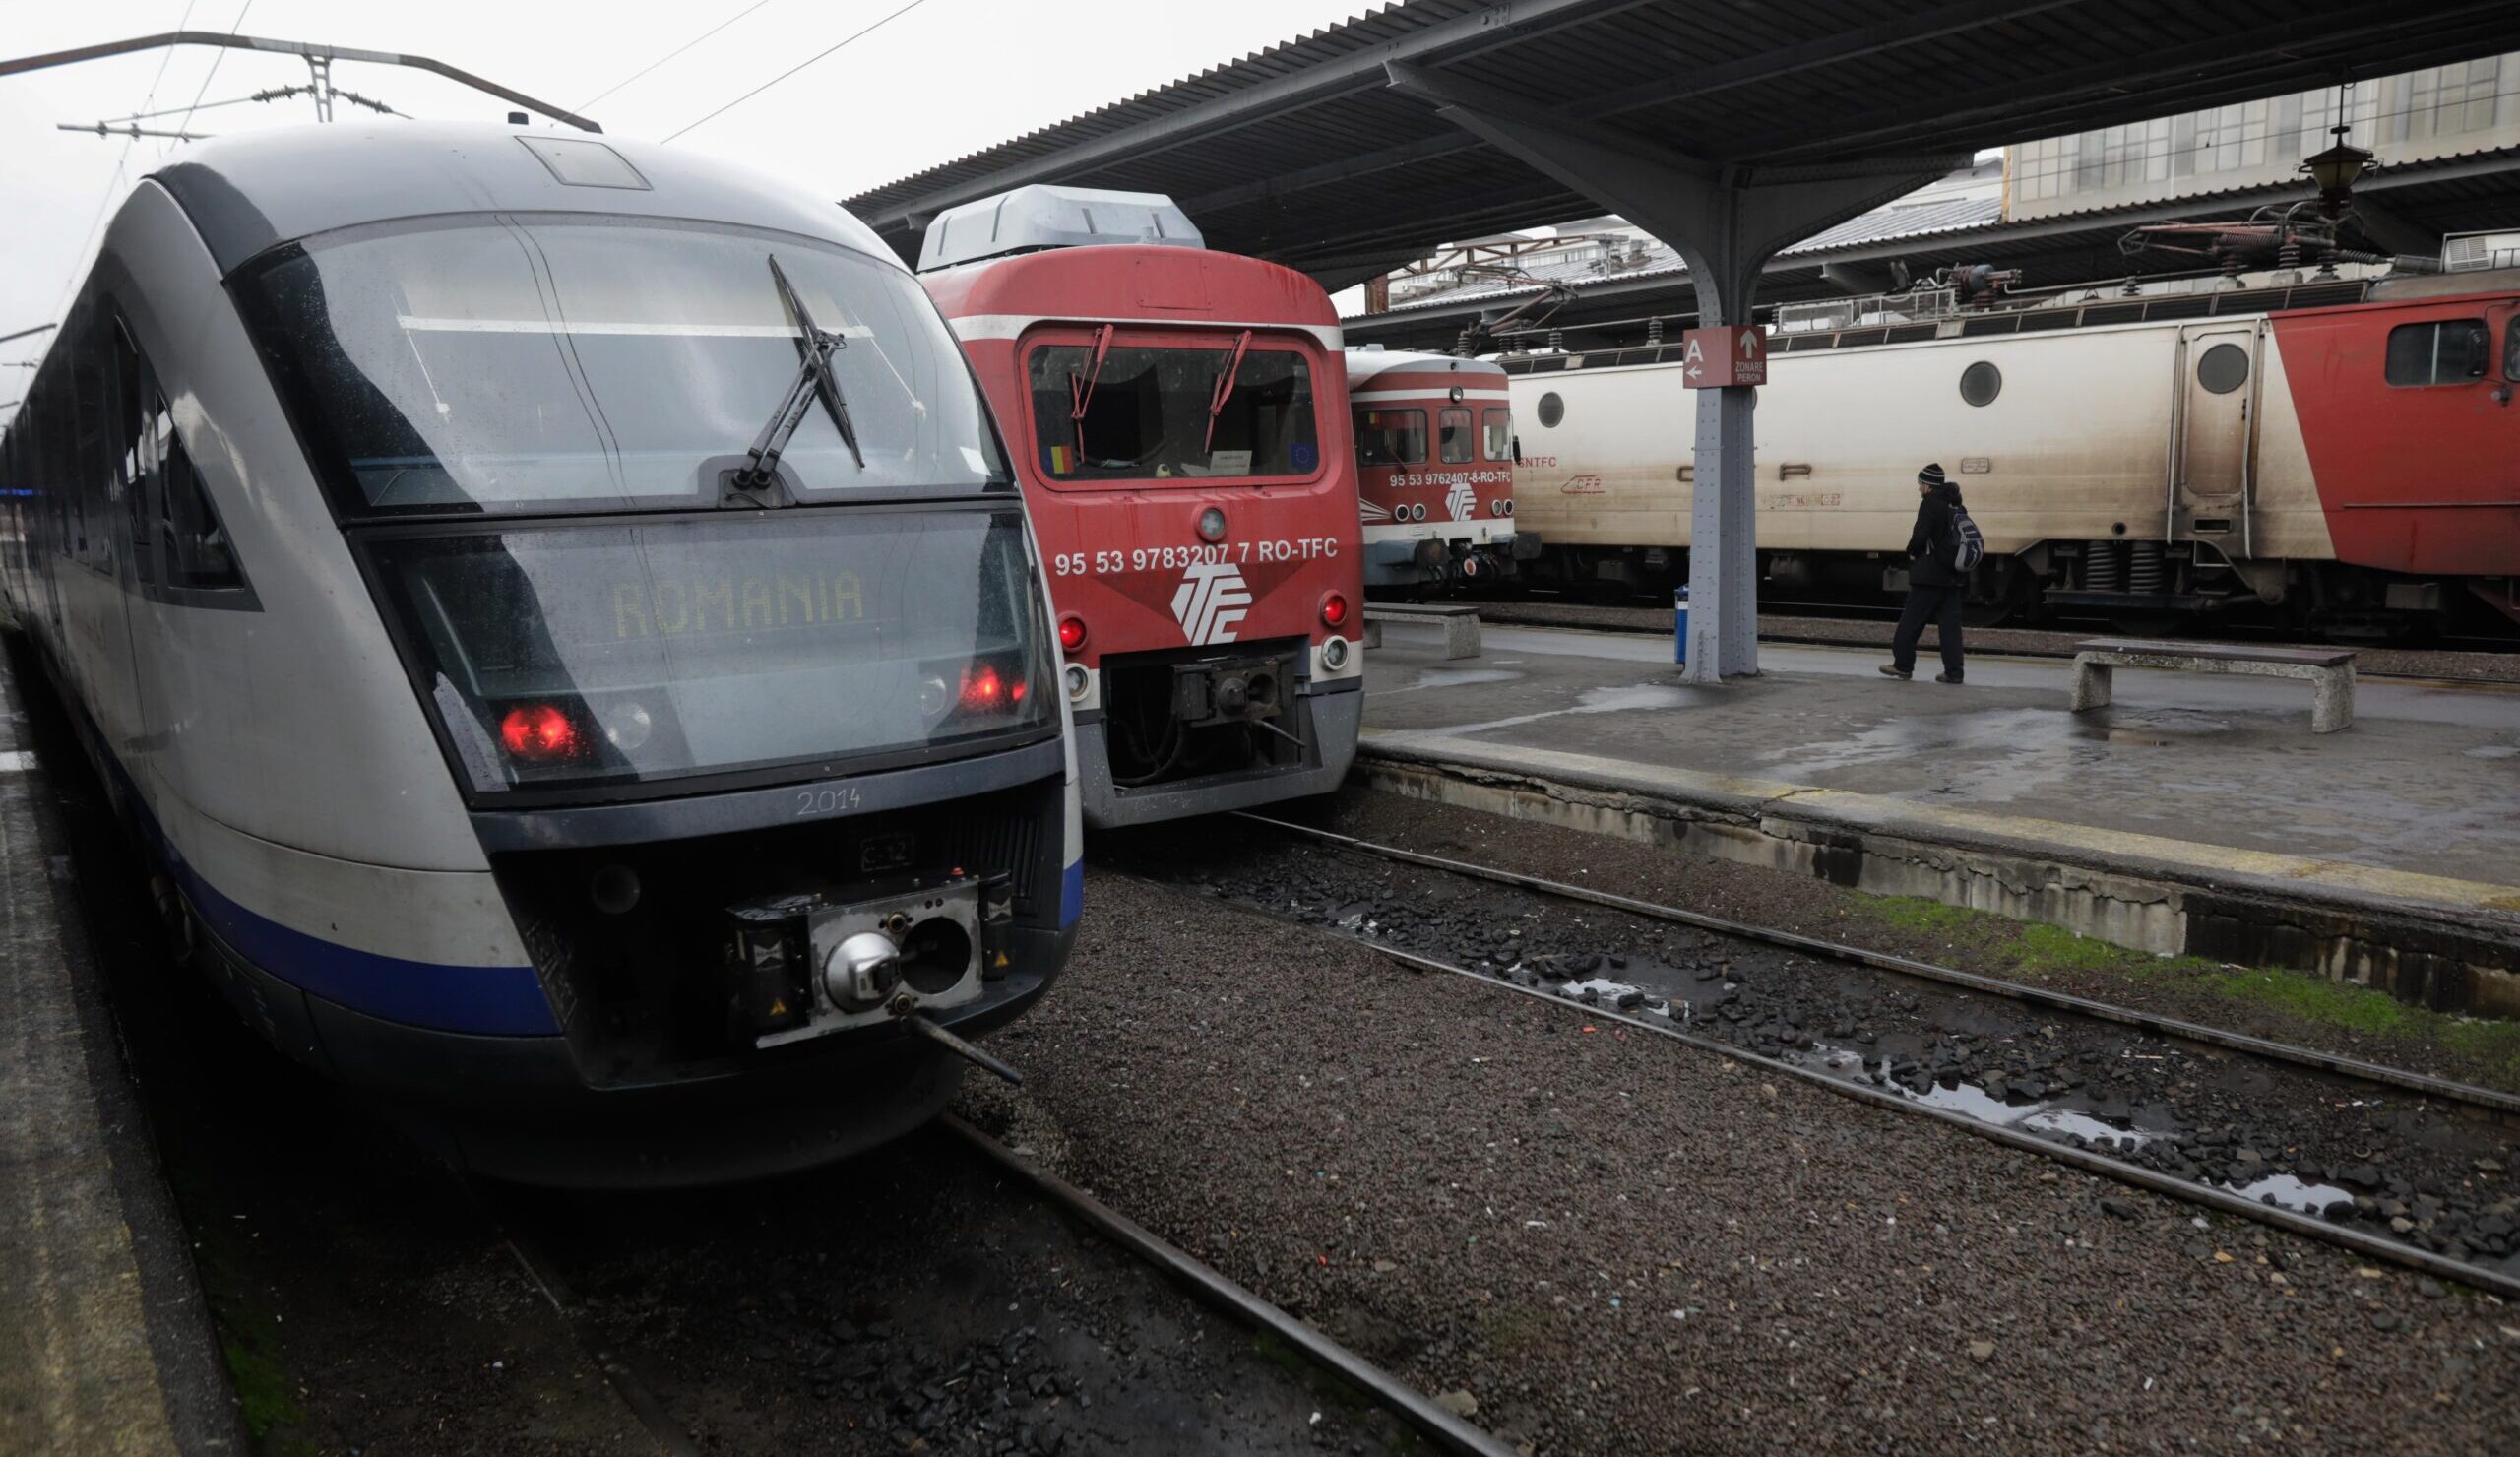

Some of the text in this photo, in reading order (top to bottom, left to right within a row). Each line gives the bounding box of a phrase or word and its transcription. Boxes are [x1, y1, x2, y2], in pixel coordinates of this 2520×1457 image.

[1685, 339, 1704, 363] A
[1735, 361, 1763, 373] ZONARE
[1737, 373, 1761, 382] PERON
[1518, 456, 1556, 468] SNTFC
[1390, 475, 1405, 486] 95
[1409, 474, 1422, 485] 53
[1055, 538, 1338, 576] 95 53 9783207 7 RO-TFC
[613, 571, 863, 637] ROMANIA
[797, 788, 861, 816] 2014
